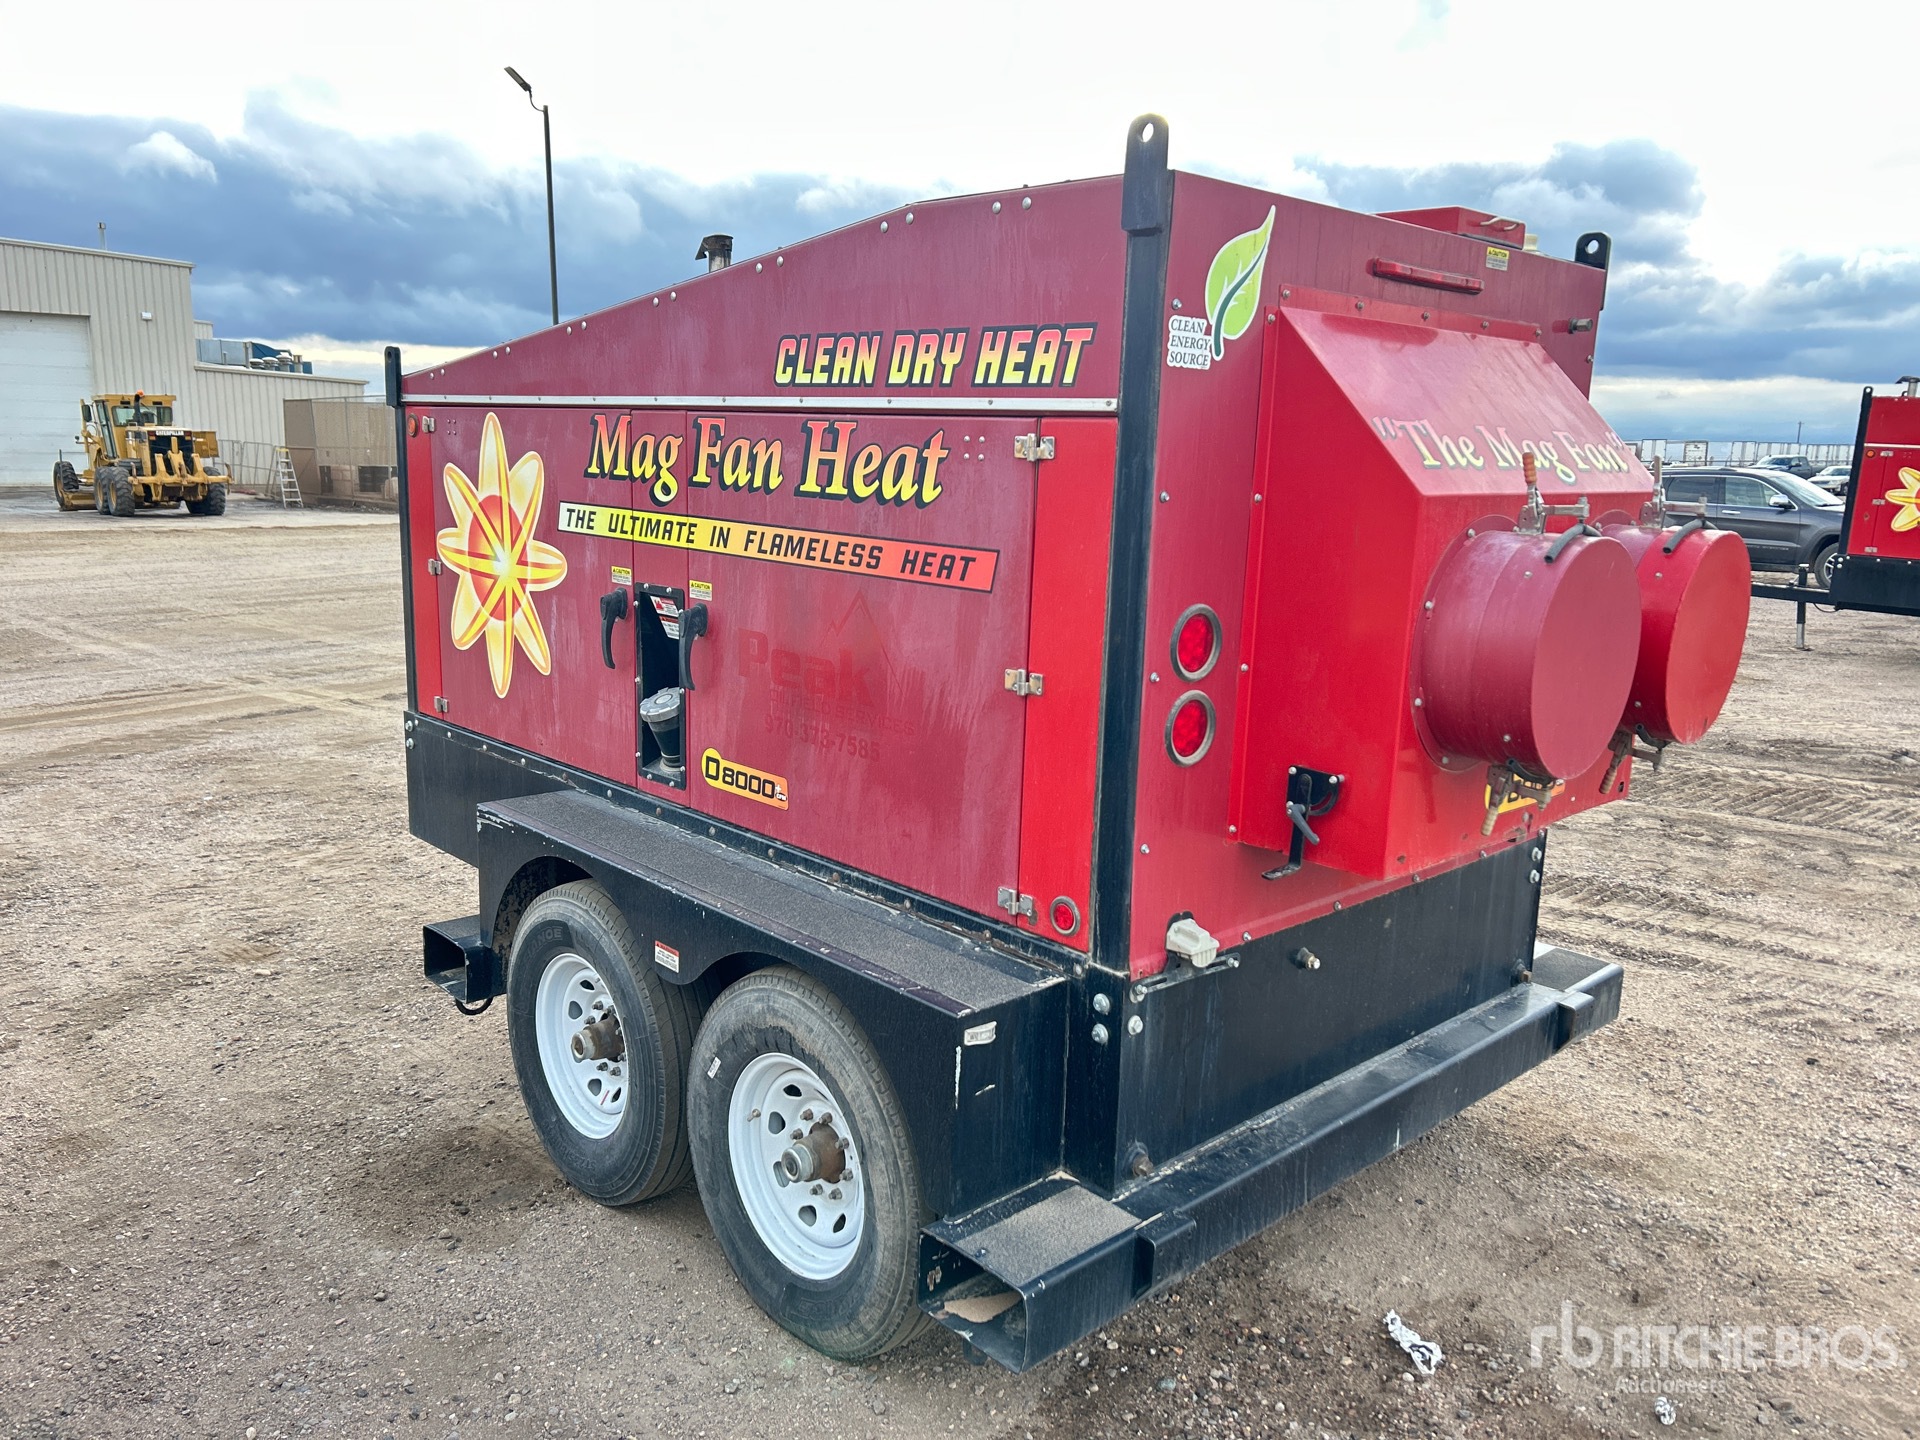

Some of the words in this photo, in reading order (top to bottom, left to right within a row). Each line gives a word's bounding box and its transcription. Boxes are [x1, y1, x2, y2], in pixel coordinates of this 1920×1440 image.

[775, 332, 883, 387] CLEAN
[886, 329, 969, 387] DRY
[973, 324, 1097, 387] HEAT
[1170, 318, 1205, 334] CLEAN
[1170, 334, 1211, 350] ENERGY
[1169, 351, 1209, 366] SOURCE
[585, 414, 684, 507] Mag
[690, 417, 784, 494] Fan
[796, 420, 951, 508] Heat
[1475, 425, 1577, 485] Mag
[566, 507, 597, 530] THE
[608, 513, 698, 545] ULTIMATE
[709, 525, 731, 549] IN
[744, 530, 883, 570] FLAMELESS
[900, 550, 977, 582] HEAT
[694, 582, 711, 590] CAUTION
[738, 628, 874, 707] Peak
